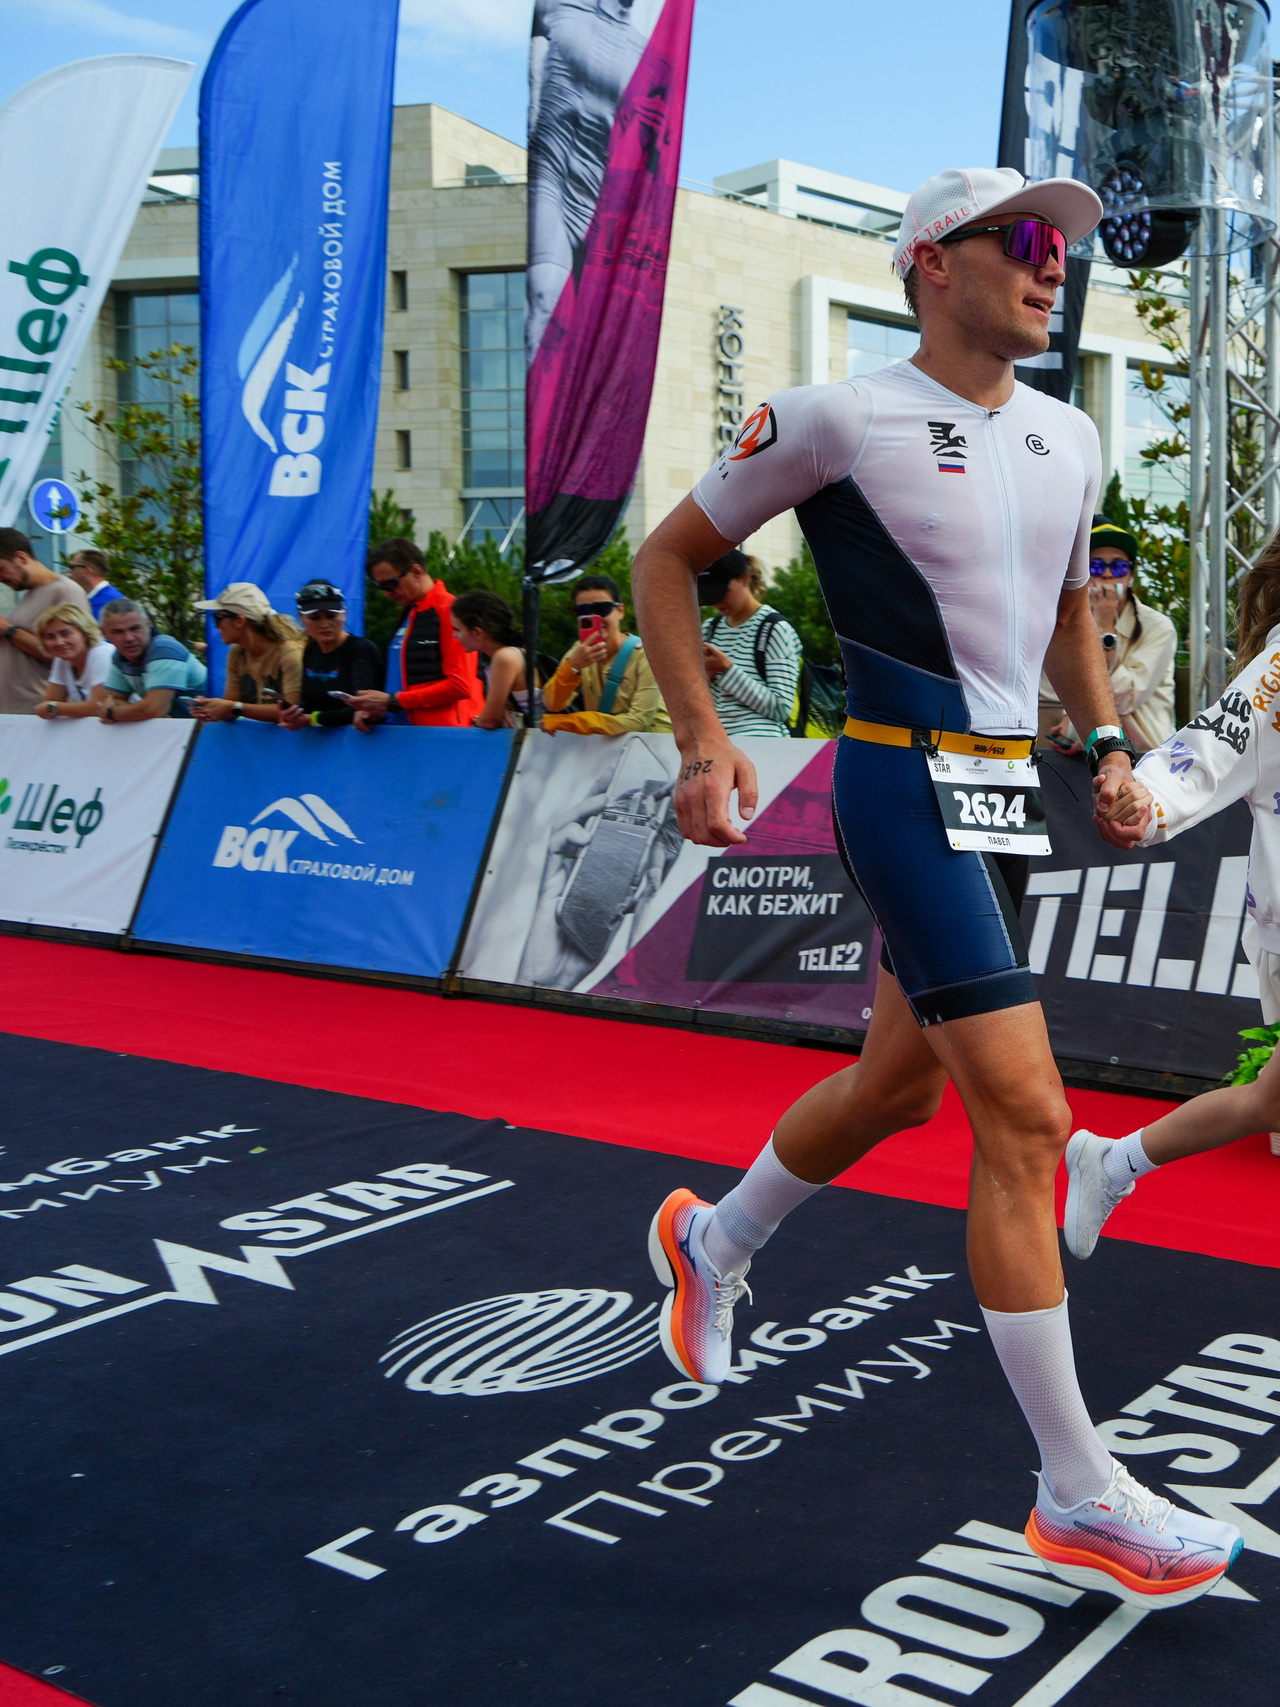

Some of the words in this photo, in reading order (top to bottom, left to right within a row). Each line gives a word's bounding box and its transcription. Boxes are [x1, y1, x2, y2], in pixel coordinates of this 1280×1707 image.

[322, 161, 346, 217] ДОМ
[924, 207, 970, 239] TRAIL
[319, 222, 345, 358] СТРАХОВОЙ
[268, 361, 332, 497] ВСК
[934, 762, 952, 774] STAR
[13, 782, 104, 849] Шеф
[952, 790, 1027, 829] 2624
[212, 825, 300, 874] ВСК
[289, 858, 375, 884] СТРАХОВОЙ
[374, 867, 414, 886] ДОМ
[987, 836, 1012, 847] ПАВЕЛ
[706, 894, 755, 916] КАК
[757, 893, 844, 915] БЕЖИТ
[712, 866, 815, 891] СМОТРИ,
[798, 941, 864, 972] TELE2
[219, 1162, 492, 1242] STAR
[305, 1264, 955, 1581] Газпромбанк
[544, 1318, 981, 1545] Премиум
